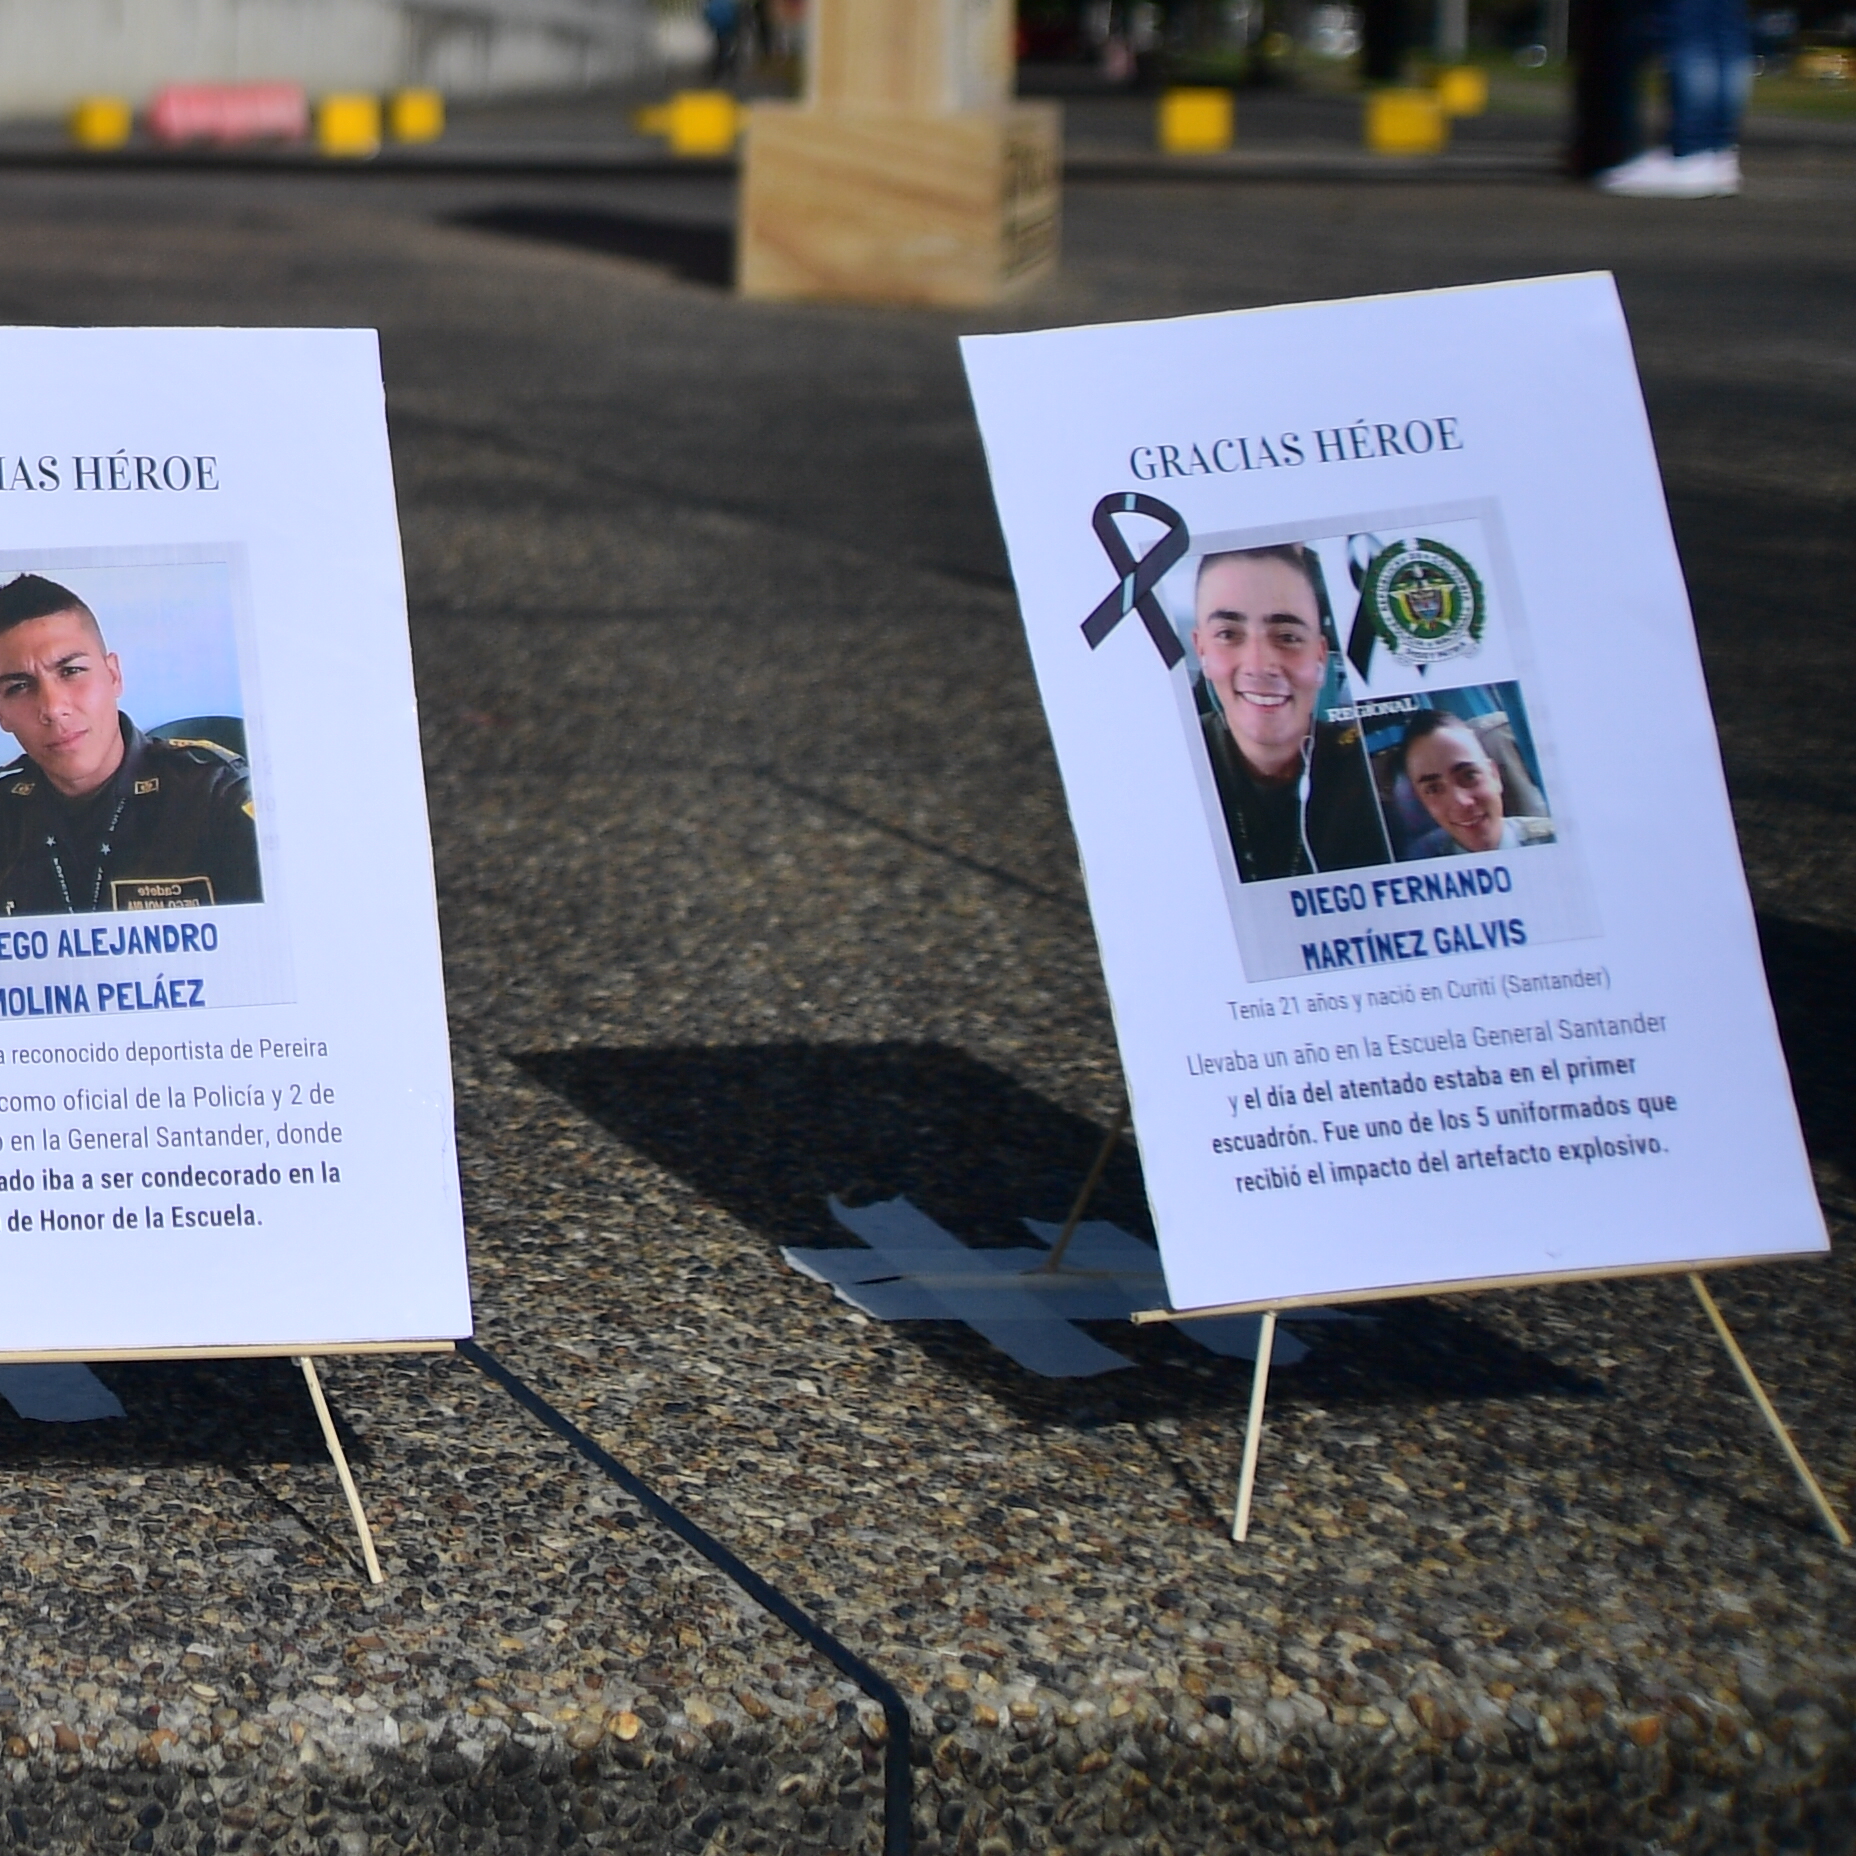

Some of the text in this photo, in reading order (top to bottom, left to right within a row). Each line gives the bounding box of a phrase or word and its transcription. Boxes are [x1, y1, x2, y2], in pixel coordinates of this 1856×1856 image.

[72, 448, 219, 491] HÉROE
[1130, 417, 1463, 480] GRACIAS HÉROE
[1289, 866, 1512, 917] DIEGO FERNANDO
[58, 923, 218, 958] ALEJANDRO
[1301, 918, 1527, 971] MARTÍNEZ GALVIS
[97, 973, 205, 1012] PELÁEZ
[1278, 996, 1300, 1016] 21
[1306, 992, 1349, 1013] años
[1351, 994, 1362, 1013] y
[1366, 984, 1416, 1007] nació
[1420, 986, 1443, 1002] en
[1501, 966, 1611, 999] (Santander)
[12, 1041, 119, 1064] reconocido
[126, 1040, 224, 1066] deportista
[230, 1038, 253, 1059] de
[259, 1037, 328, 1058] Pereira
[1186, 1012, 1666, 1076] Llevaba un año en la Escuela General Santander
[63, 1087, 128, 1111] oficial
[136, 1087, 160, 1109] de
[168, 1086, 186, 1108] la
[193, 1084, 265, 1107] Policía
[271, 1089, 282, 1111] y
[290, 1084, 303, 1105] 2
[309, 1082, 334, 1104] de
[1228, 1096, 1237, 1117] y
[1244, 1087, 1262, 1110] el
[1303, 1080, 1333, 1104] del
[1339, 1072, 1427, 1100] atentado
[1433, 1065, 1503, 1091] estaba
[1509, 1067, 1535, 1084] en
[1541, 1058, 1560, 1081] el
[1565, 1056, 1635, 1085] primer
[11, 1135, 35, 1151] en
[43, 1128, 60, 1151] la
[68, 1126, 148, 1150] General
[156, 1123, 270, 1148] Santander,
[277, 1121, 342, 1144] donde
[1212, 1095, 1677, 1154] escuadrón. Fue uno de los 5 uniformados que
[42, 1168, 74, 1191] iba
[82, 1173, 93, 1189] a
[101, 1172, 134, 1189] ser
[141, 1162, 281, 1188] condecorado
[289, 1167, 314, 1184] en
[321, 1161, 340, 1183] la
[1235, 1134, 1669, 1193] recibió el impacto del artefacto explosivo.
[7, 1209, 33, 1232] de
[40, 1209, 105, 1231] Honor
[112, 1206, 138, 1229] de
[145, 1206, 164, 1229] la
[172, 1203, 262, 1228] Escuela.
